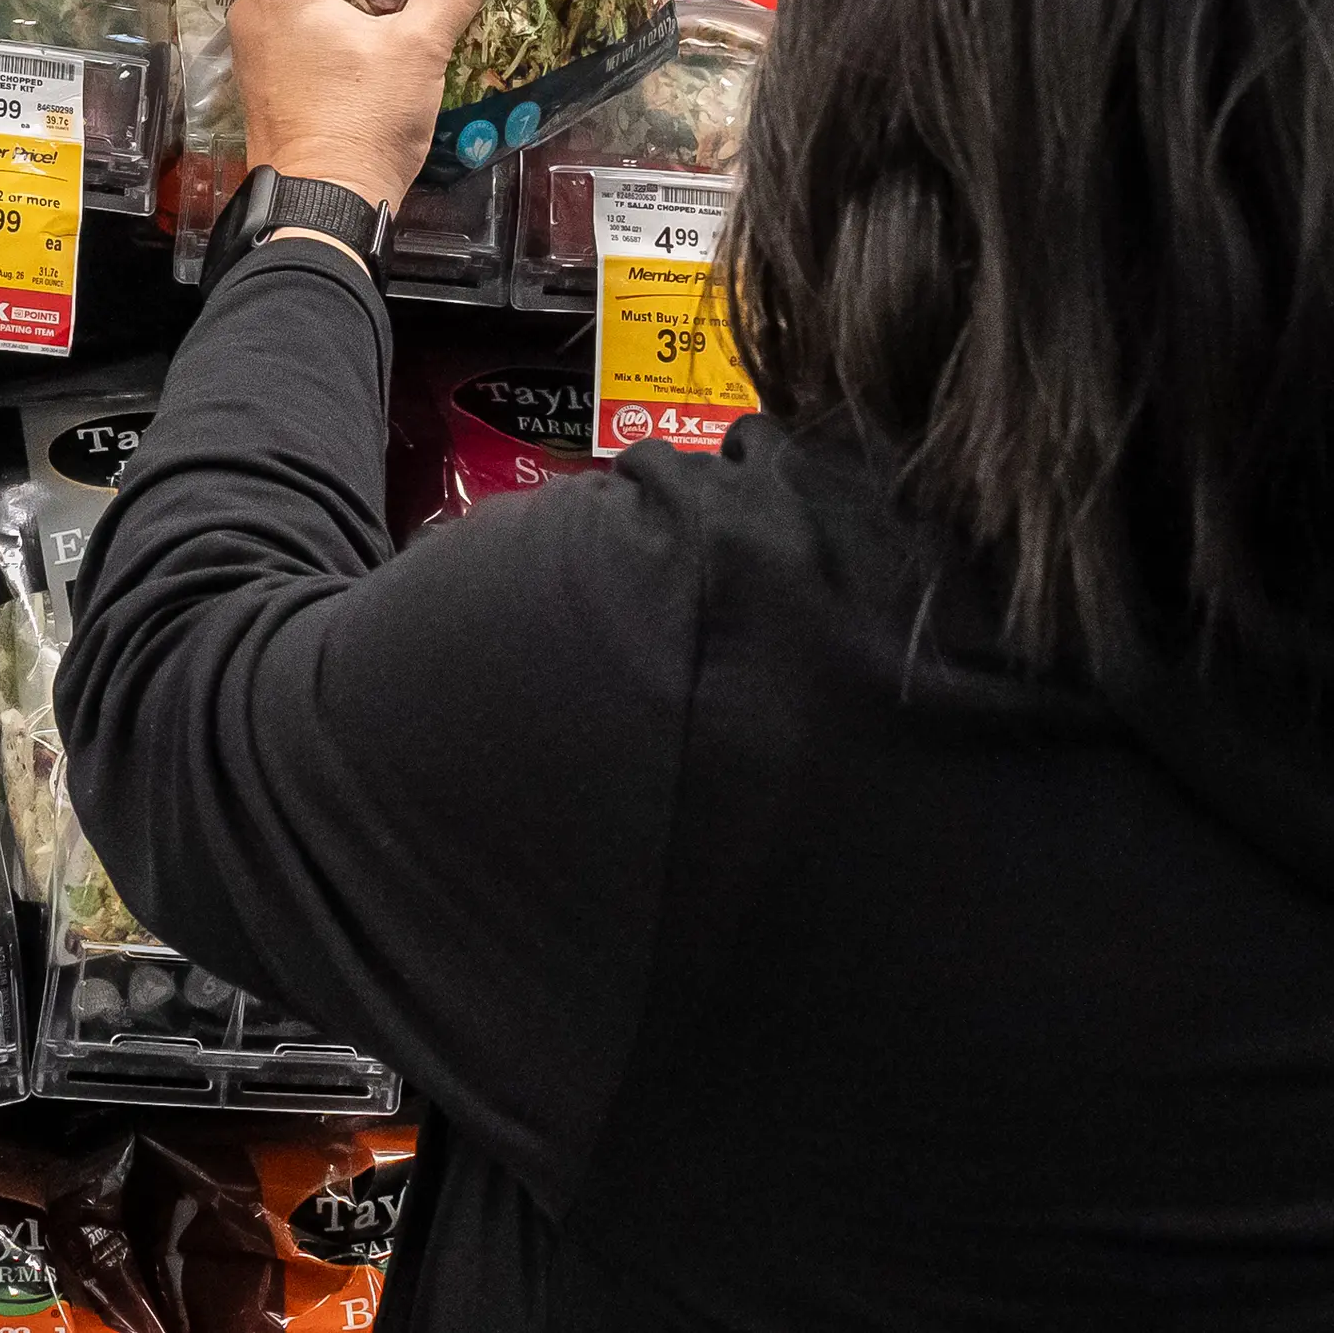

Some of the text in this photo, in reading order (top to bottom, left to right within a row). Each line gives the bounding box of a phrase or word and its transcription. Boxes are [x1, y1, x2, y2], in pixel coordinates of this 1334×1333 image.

[19, 85, 35, 93] KIT
[39, 266, 59, 278] 31.7¢
[32, 277, 64, 288] PER OUNCE
